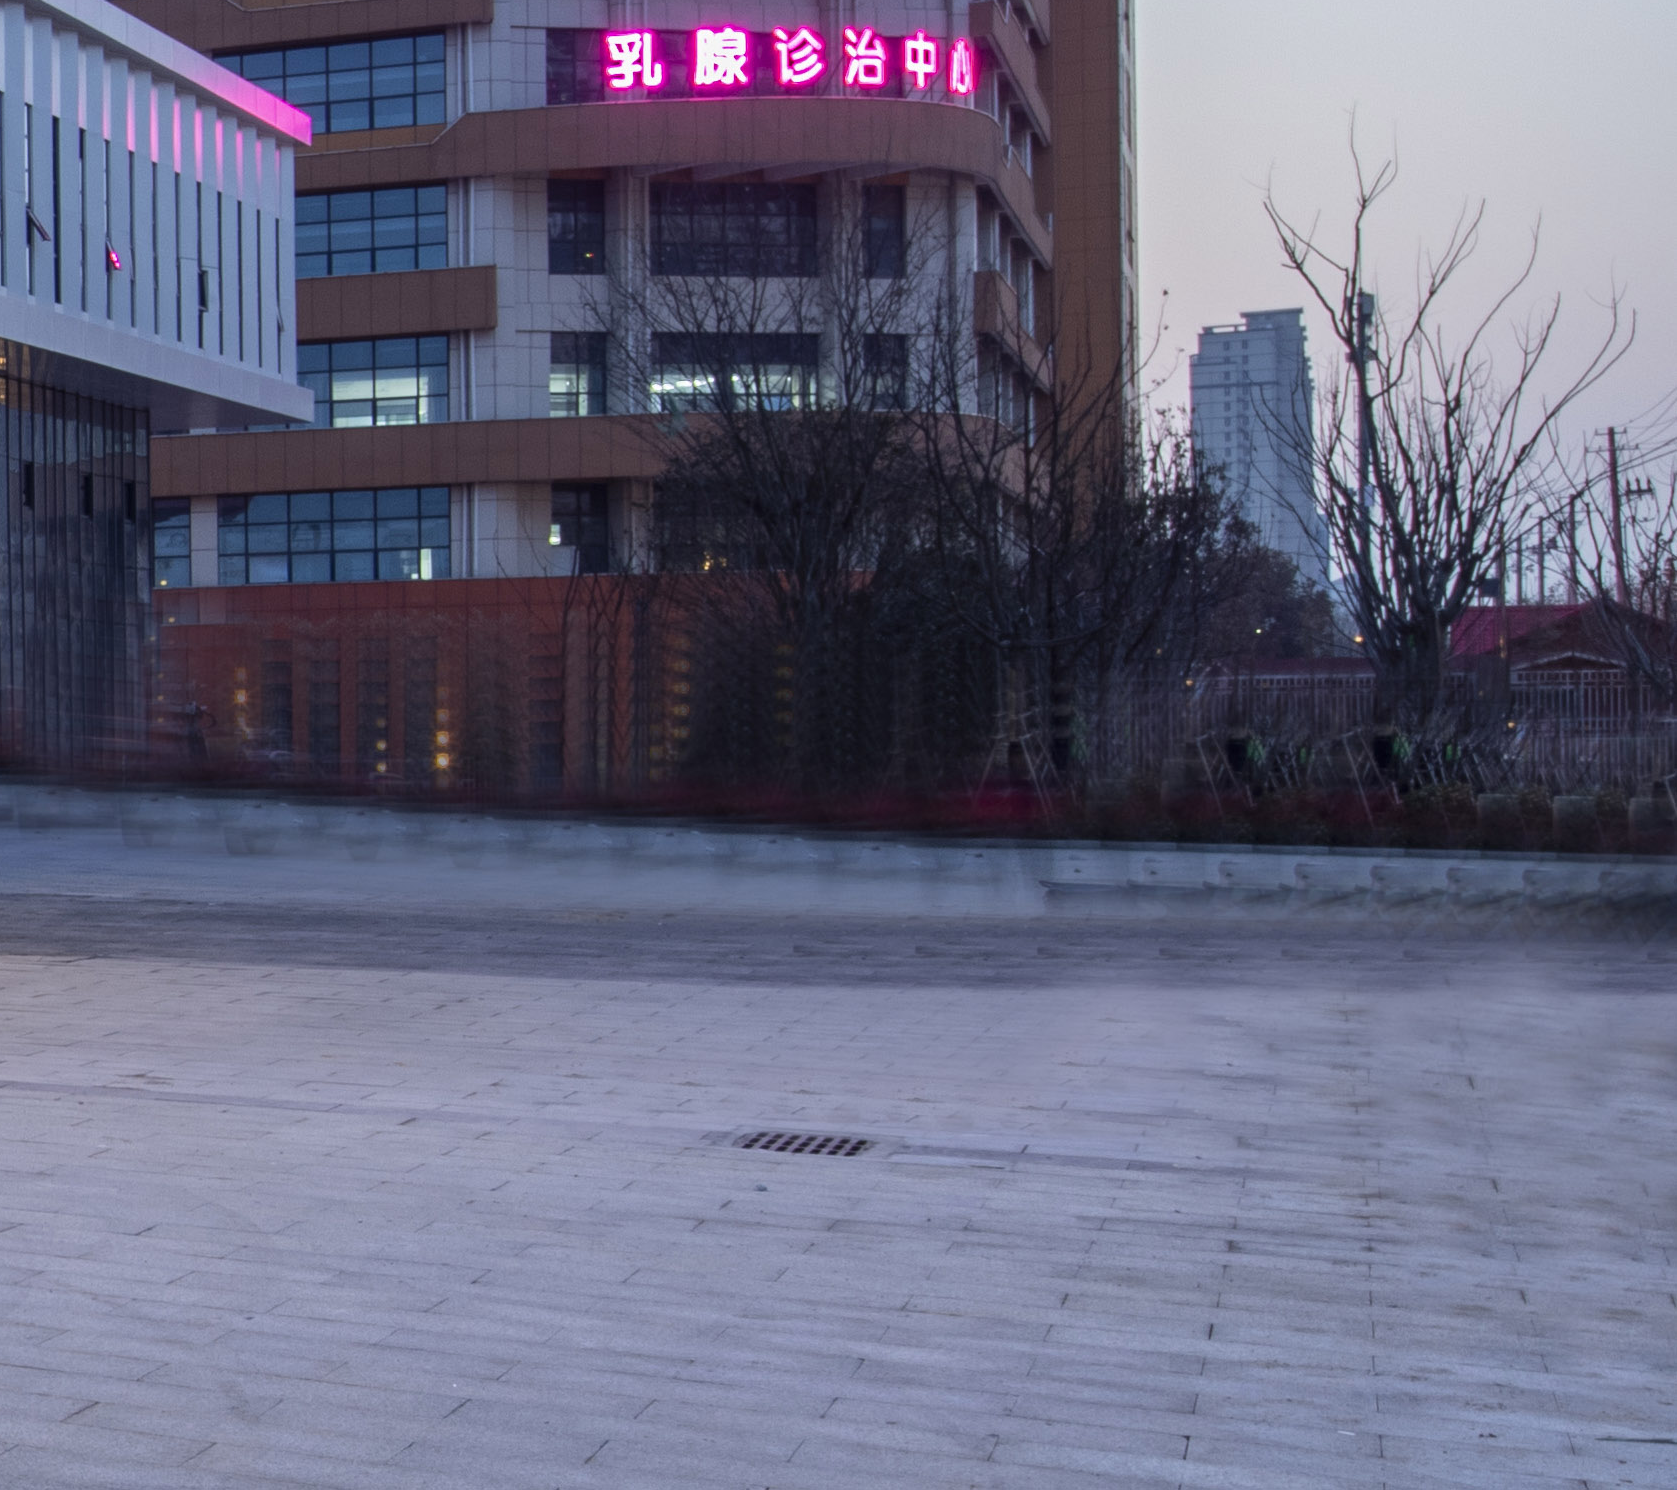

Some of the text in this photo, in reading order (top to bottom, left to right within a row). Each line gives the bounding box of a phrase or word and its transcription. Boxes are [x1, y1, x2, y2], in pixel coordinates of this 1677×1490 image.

[605, 26, 973, 93] 乳腺诊治中心
